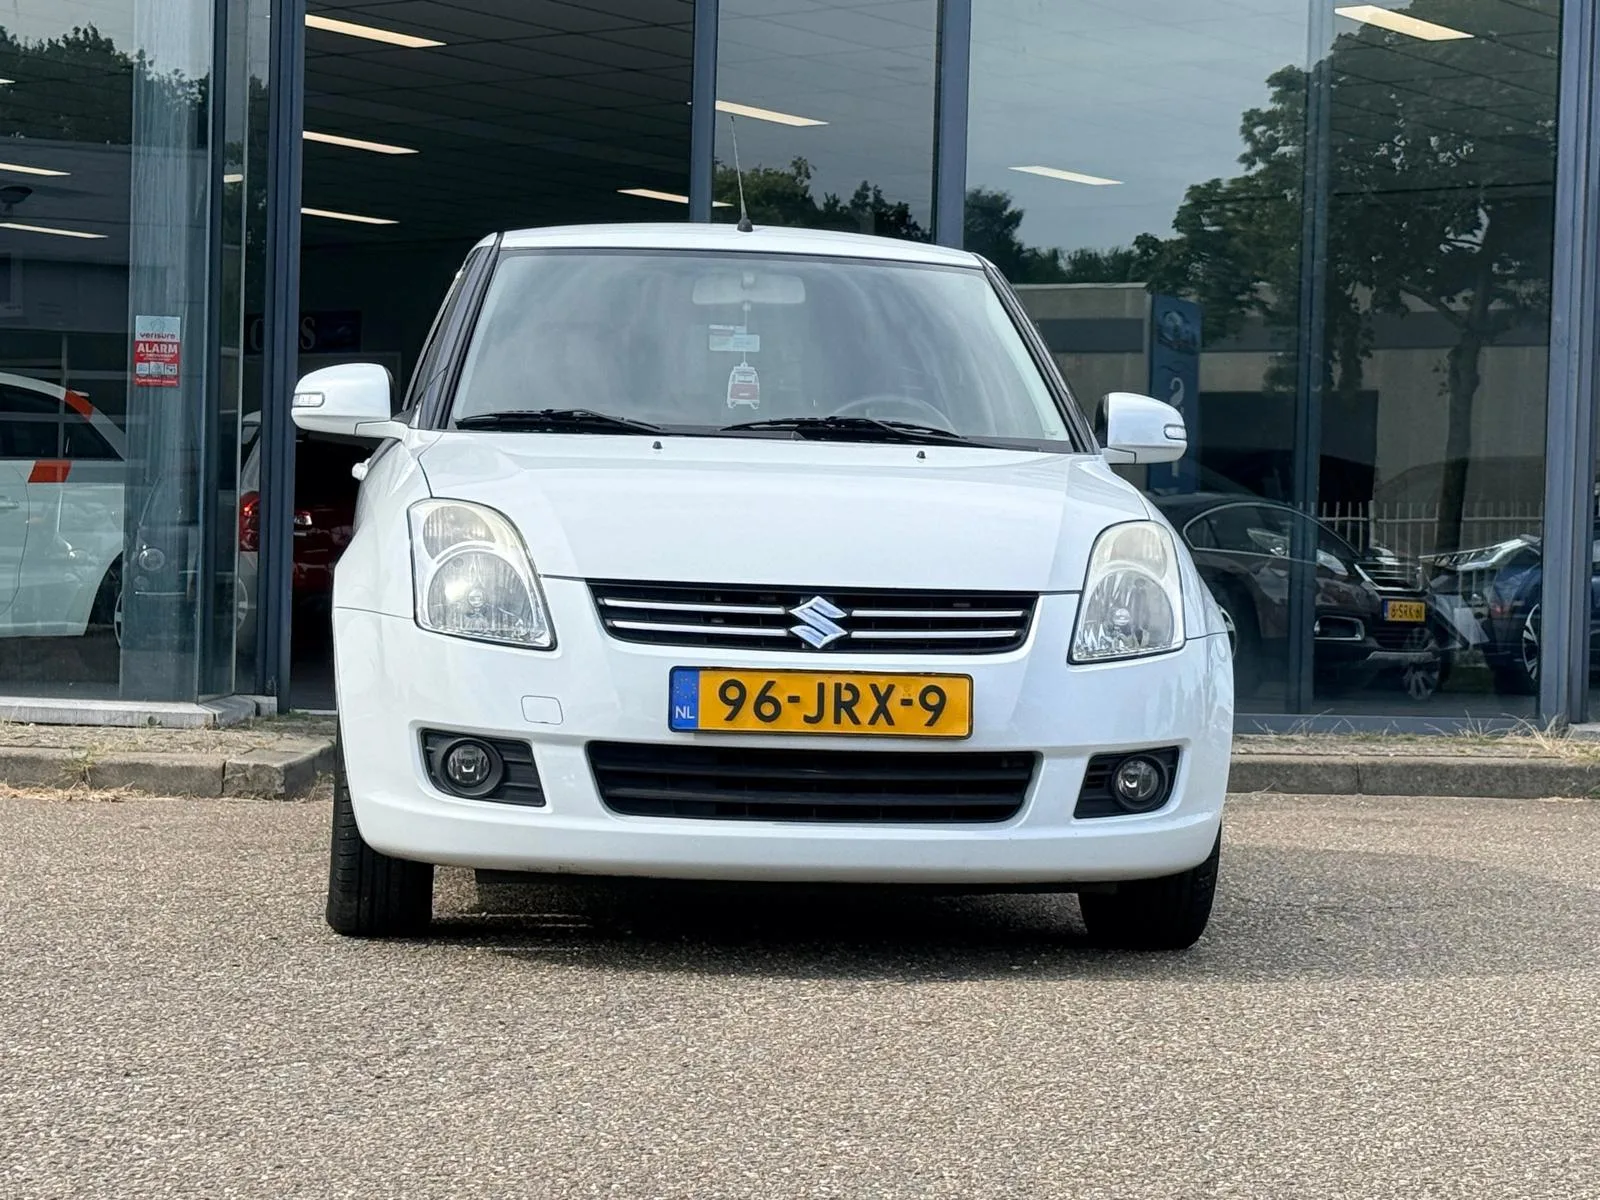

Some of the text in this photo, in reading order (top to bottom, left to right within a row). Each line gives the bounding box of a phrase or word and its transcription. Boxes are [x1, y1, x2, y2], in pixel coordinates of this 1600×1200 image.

[137, 342, 177, 354] ALARM
[718, 678, 948, 728] 96-JRX-9
[675, 705, 695, 720] NL
